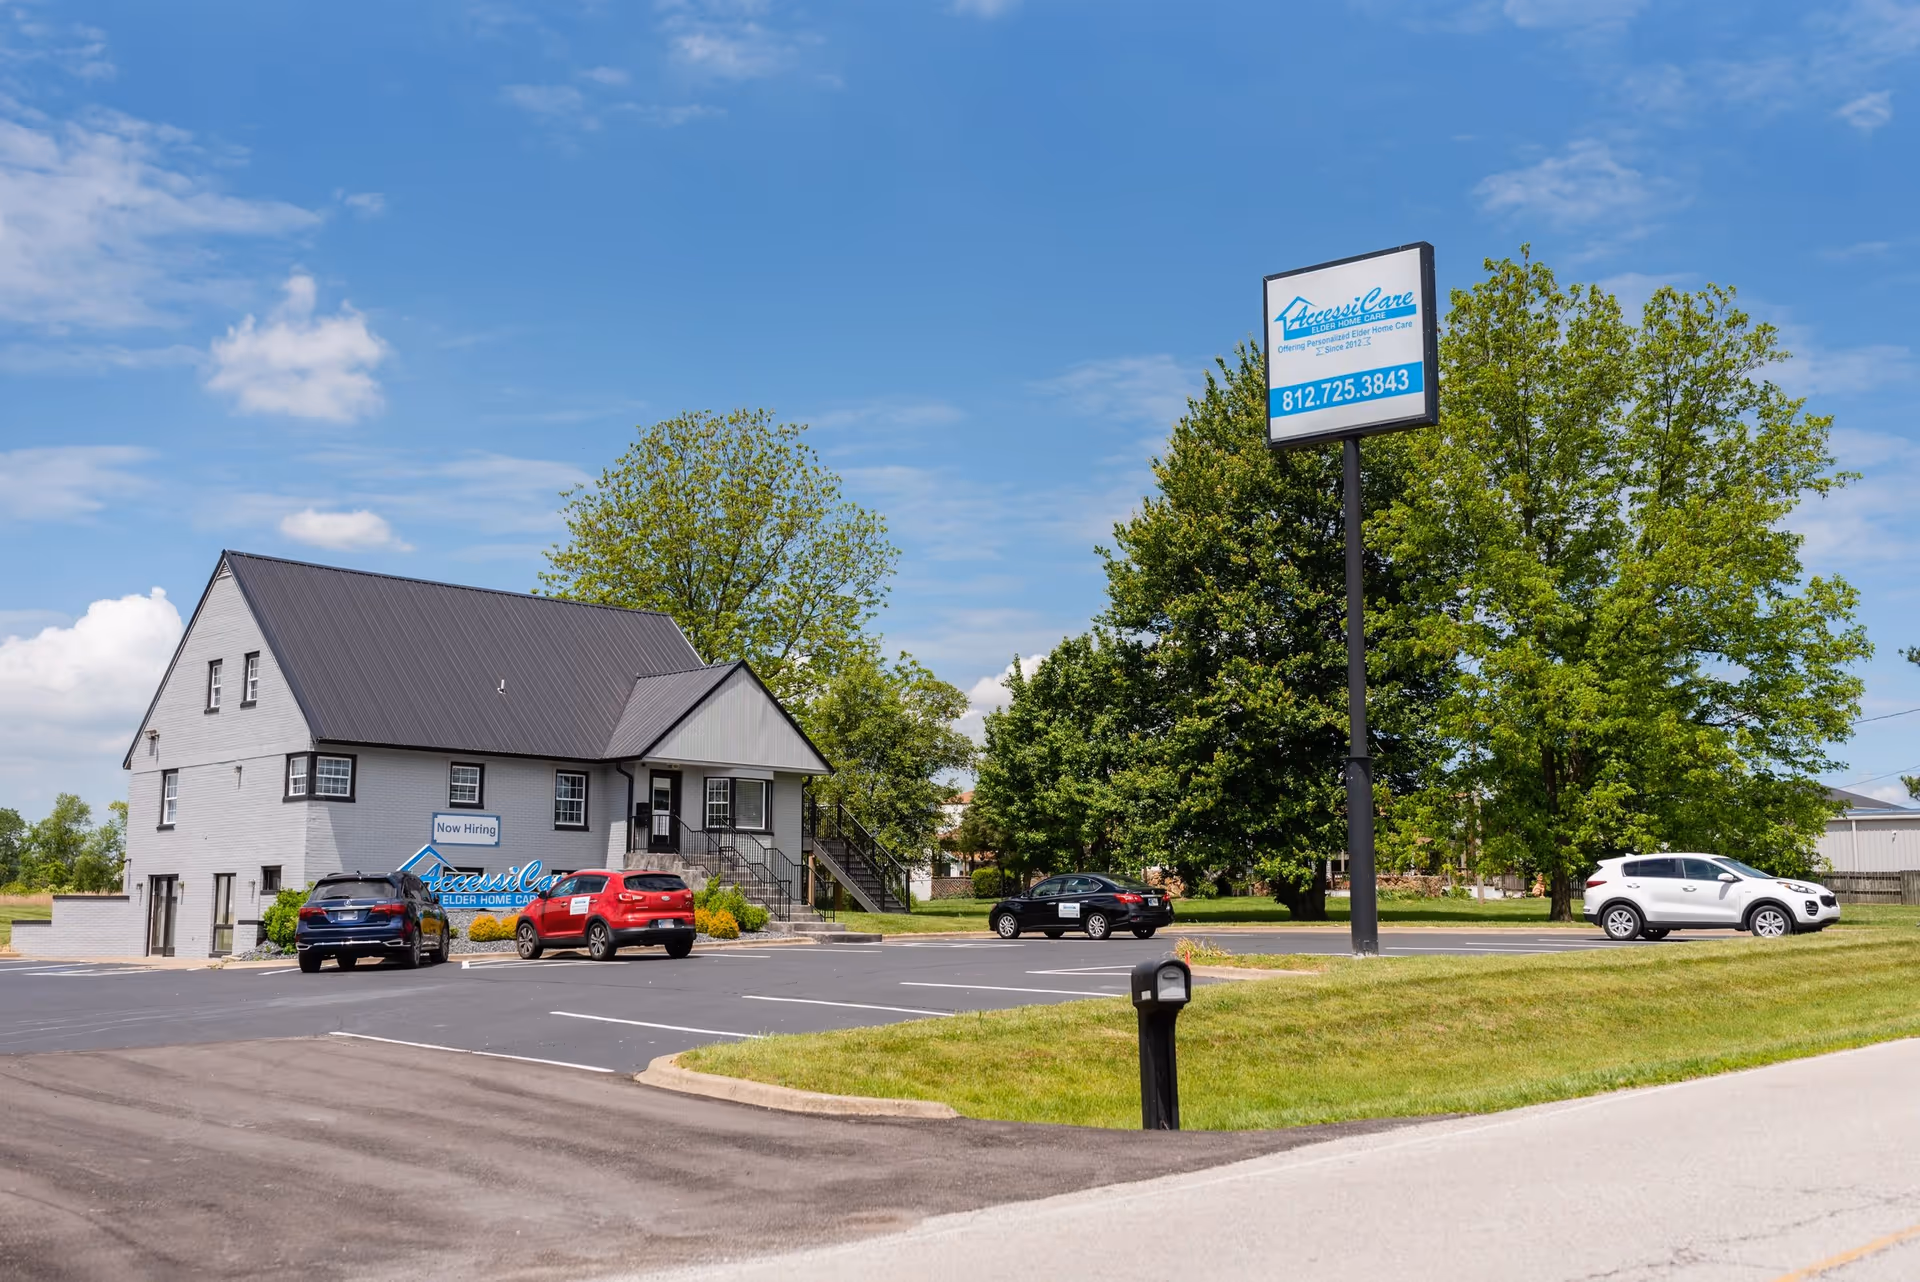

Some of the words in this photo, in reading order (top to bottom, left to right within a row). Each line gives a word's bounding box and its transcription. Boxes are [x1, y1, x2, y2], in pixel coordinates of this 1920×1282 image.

[1287, 287, 1414, 330] AccessiCare
[1311, 323, 1336, 334] ELDER
[1338, 317, 1362, 328] HOME
[1364, 312, 1386, 322] CARE
[1278, 343, 1306, 354] Offering
[1306, 331, 1350, 348] Personalized
[1351, 328, 1370, 338] Elder
[1371, 324, 1394, 334] Home
[1395, 320, 1413, 330] Care
[1324, 344, 1344, 355] Since
[1345, 339, 1362, 349] 2012
[1282, 369, 1410, 411] 812.725.3843
[437, 822, 461, 833] Now
[464, 823, 496, 837] Hiring
[442, 894, 477, 905] ELDER
[480, 894, 512, 905] HOME
